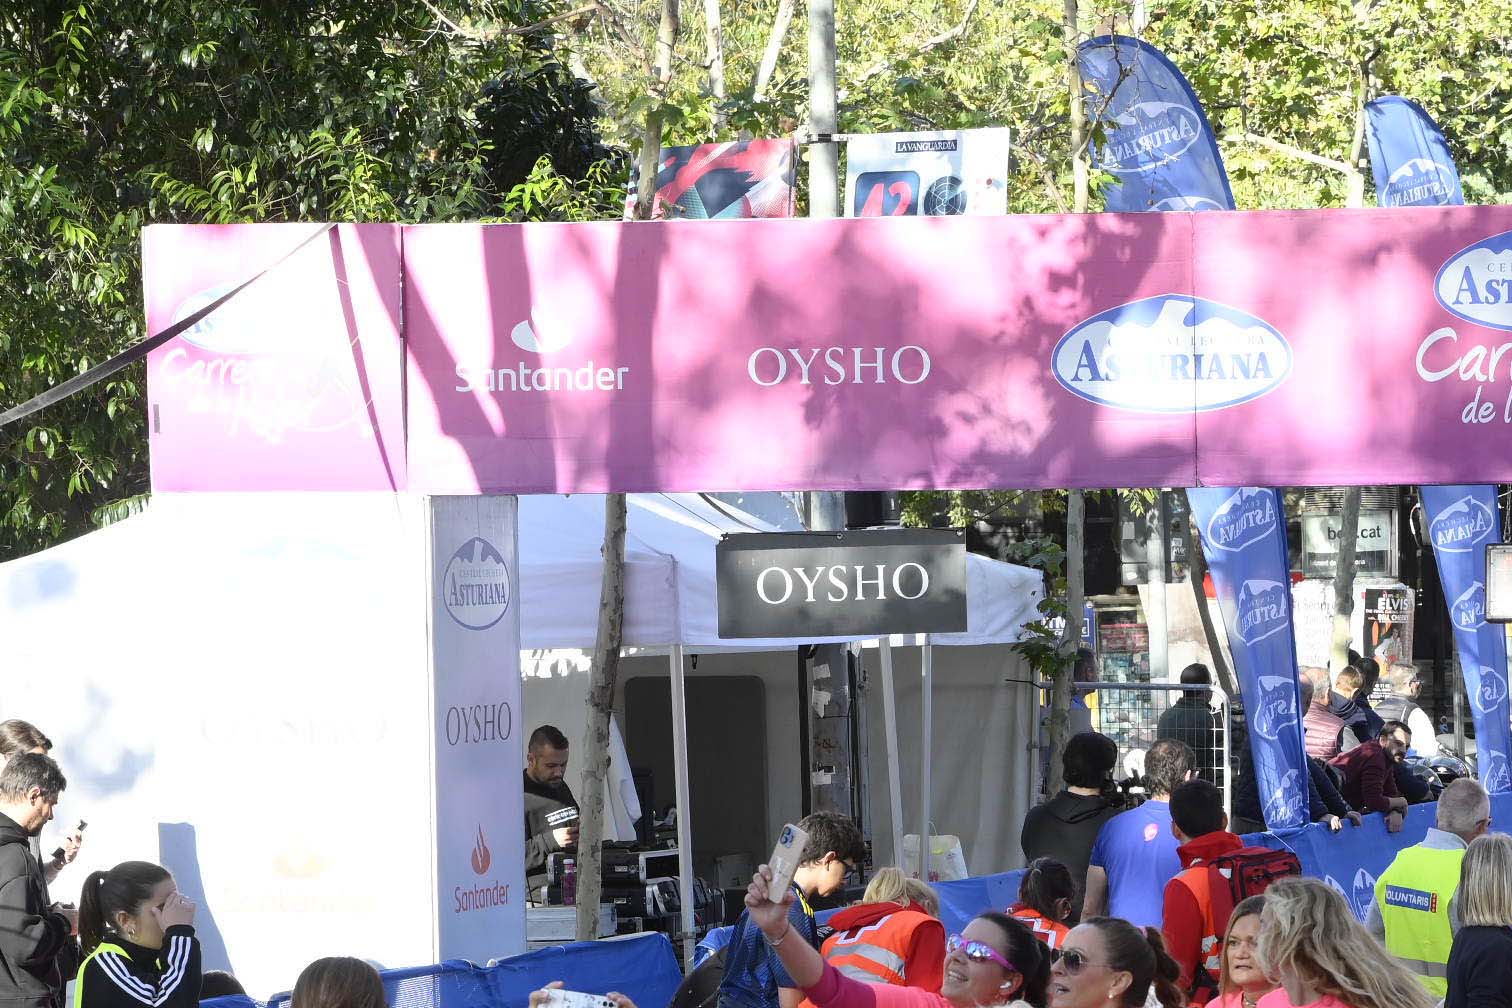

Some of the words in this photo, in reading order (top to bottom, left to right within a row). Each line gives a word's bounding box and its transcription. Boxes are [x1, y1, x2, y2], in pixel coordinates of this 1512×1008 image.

[455, 360, 629, 393] Santander
[747, 345, 932, 386] OYSHO
[1461, 385, 1496, 424] de
[448, 571, 507, 607] ASTURIANA
[756, 562, 930, 605] OYSHO
[446, 701, 512, 747] OYSHO
[454, 883, 510, 913] Santander
